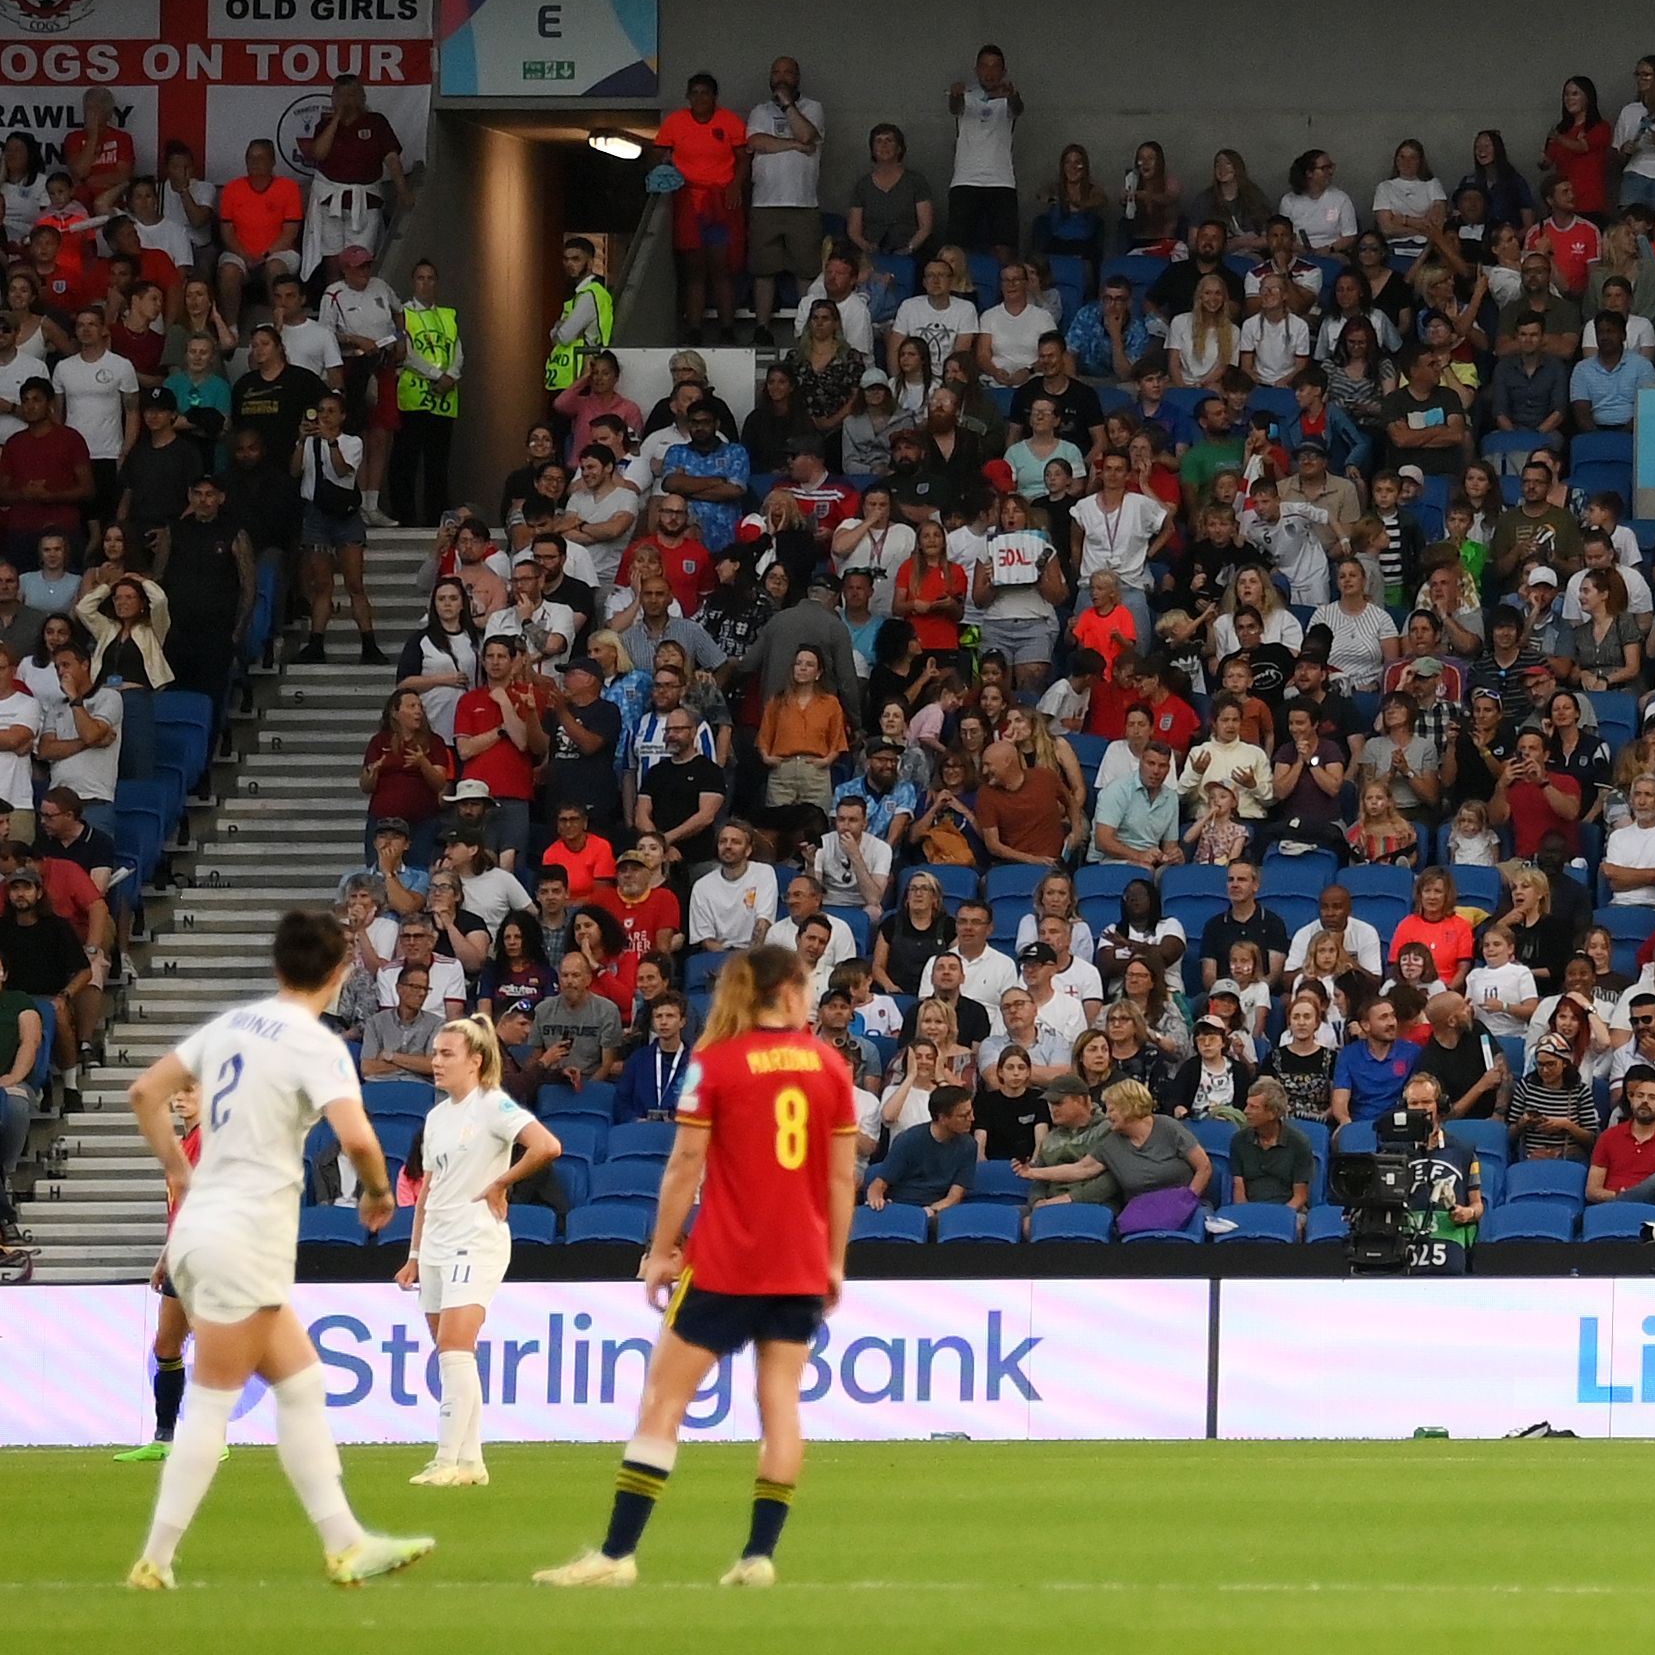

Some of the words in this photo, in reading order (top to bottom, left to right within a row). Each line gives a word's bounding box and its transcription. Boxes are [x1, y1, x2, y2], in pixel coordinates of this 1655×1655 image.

[537, 4, 563, 38] E
[142, 43, 224, 81] ON
[246, 44, 406, 82] TOUR
[182, 915, 194, 928] N
[163, 962, 176, 975] M
[118, 1049, 129, 1063] K
[210, 1051, 246, 1133] 2
[774, 1086, 809, 1171] 8
[49, 1186, 61, 1201] H
